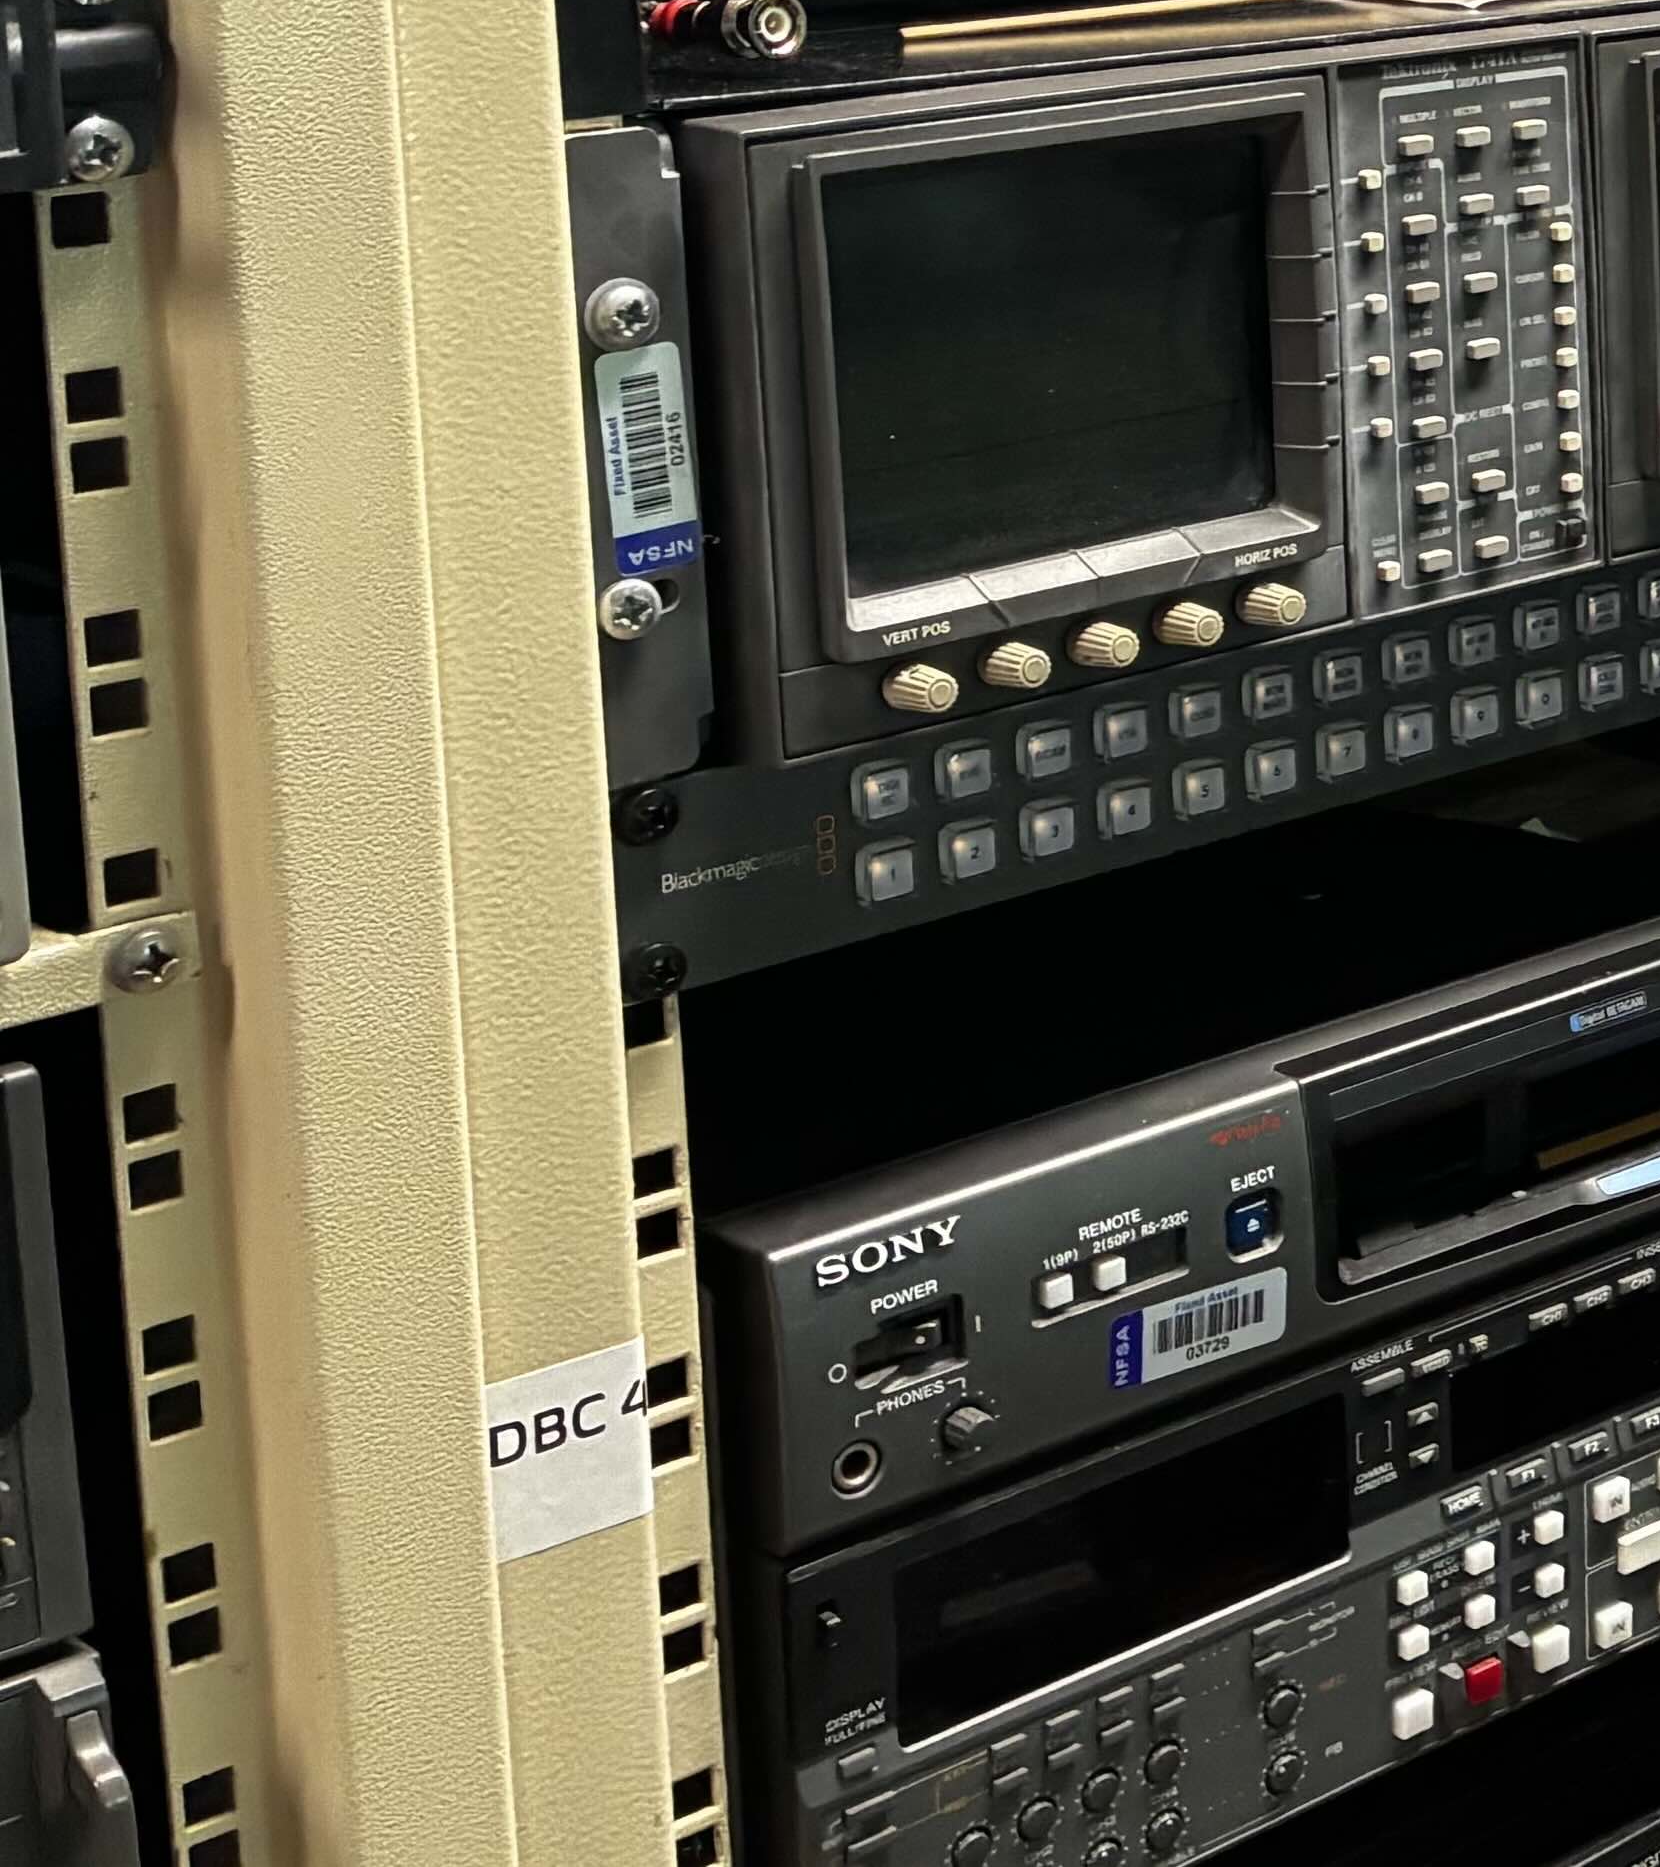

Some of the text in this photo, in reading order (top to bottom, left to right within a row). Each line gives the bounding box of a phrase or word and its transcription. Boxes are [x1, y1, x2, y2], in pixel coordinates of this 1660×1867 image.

[665, 411, 686, 467] 02416
[606, 417, 627, 497] Fixed Asset
[628, 537, 695, 567] NFSA
[1235, 542, 1298, 568] HORIZ POS
[883, 620, 951, 648] VERT POS
[1201, 784, 1210, 798] 5
[969, 846, 981, 861] 2
[1230, 1165, 1276, 1193] EJECT
[1043, 1209, 1190, 1271] 1(9P) 2(50P) RS-232C
[1078, 1208, 1144, 1241] REMOTE
[814, 1214, 962, 1289] SONY
[869, 1278, 940, 1316] POWER
[1114, 1324, 1131, 1386] NFSA
[1185, 1336, 1230, 1361] 03729
[1350, 1339, 1415, 1374] ASSEMBLE
[875, 1381, 946, 1416] PHONES
[489, 1378, 648, 1469] DBC 4
[1584, 1441, 1601, 1457] F2
[1448, 1491, 1482, 1515] HOME
[823, 1697, 888, 1734] DISPLAY
